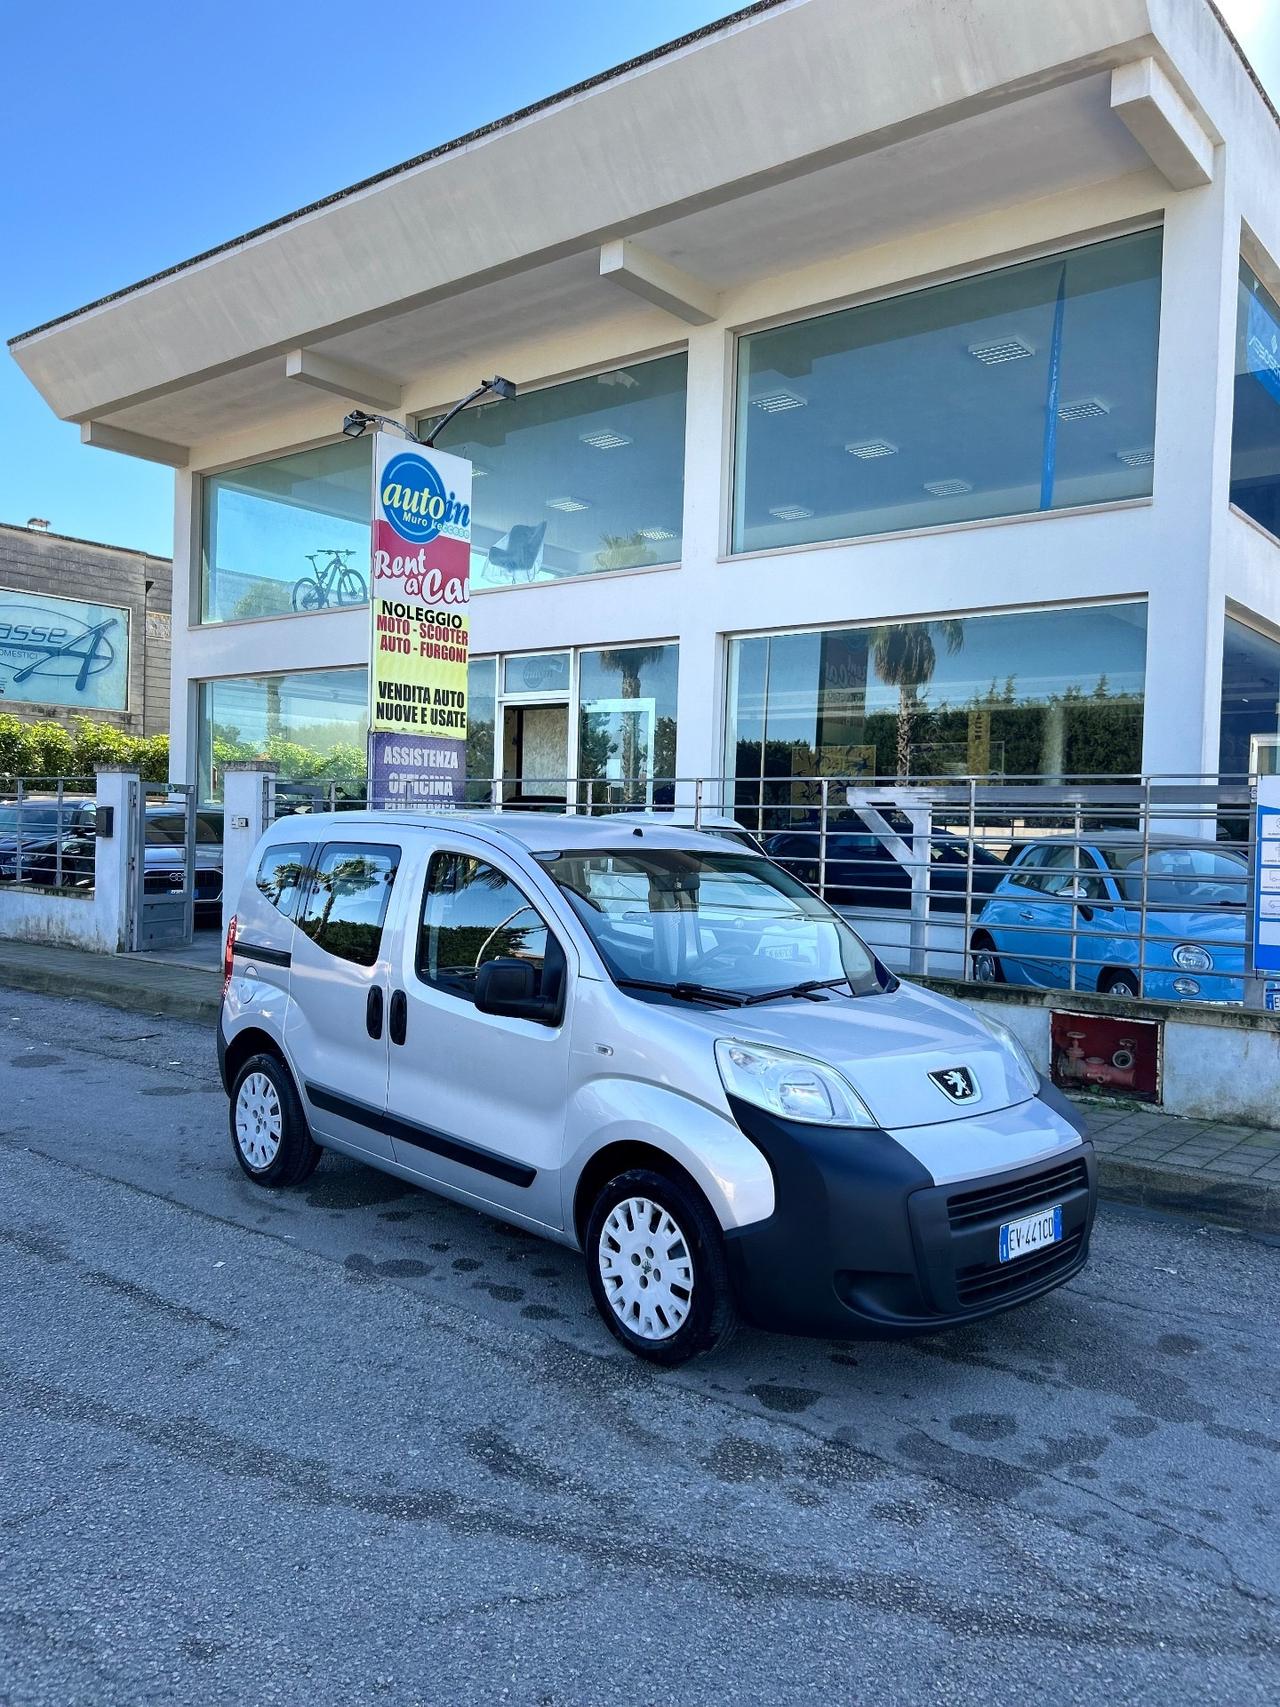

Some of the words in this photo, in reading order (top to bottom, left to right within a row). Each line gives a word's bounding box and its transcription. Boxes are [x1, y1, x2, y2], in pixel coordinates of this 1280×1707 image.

[402, 511, 428, 527] Muro
[374, 548, 427, 579] Rent
[382, 599, 463, 629] NOLEGGIO
[376, 614, 411, 636] MOTO
[419, 622, 469, 646] SCOOTER
[380, 634, 411, 655] AUTO
[419, 641, 467, 664] FURGONI
[378, 680, 431, 705] VENDITA
[433, 688, 465, 709] AUTO
[376, 701, 418, 724] NUOVE
[420, 707, 428, 725] E
[430, 708, 467, 729] USATE
[383, 745, 459, 769] ASSISTENZA
